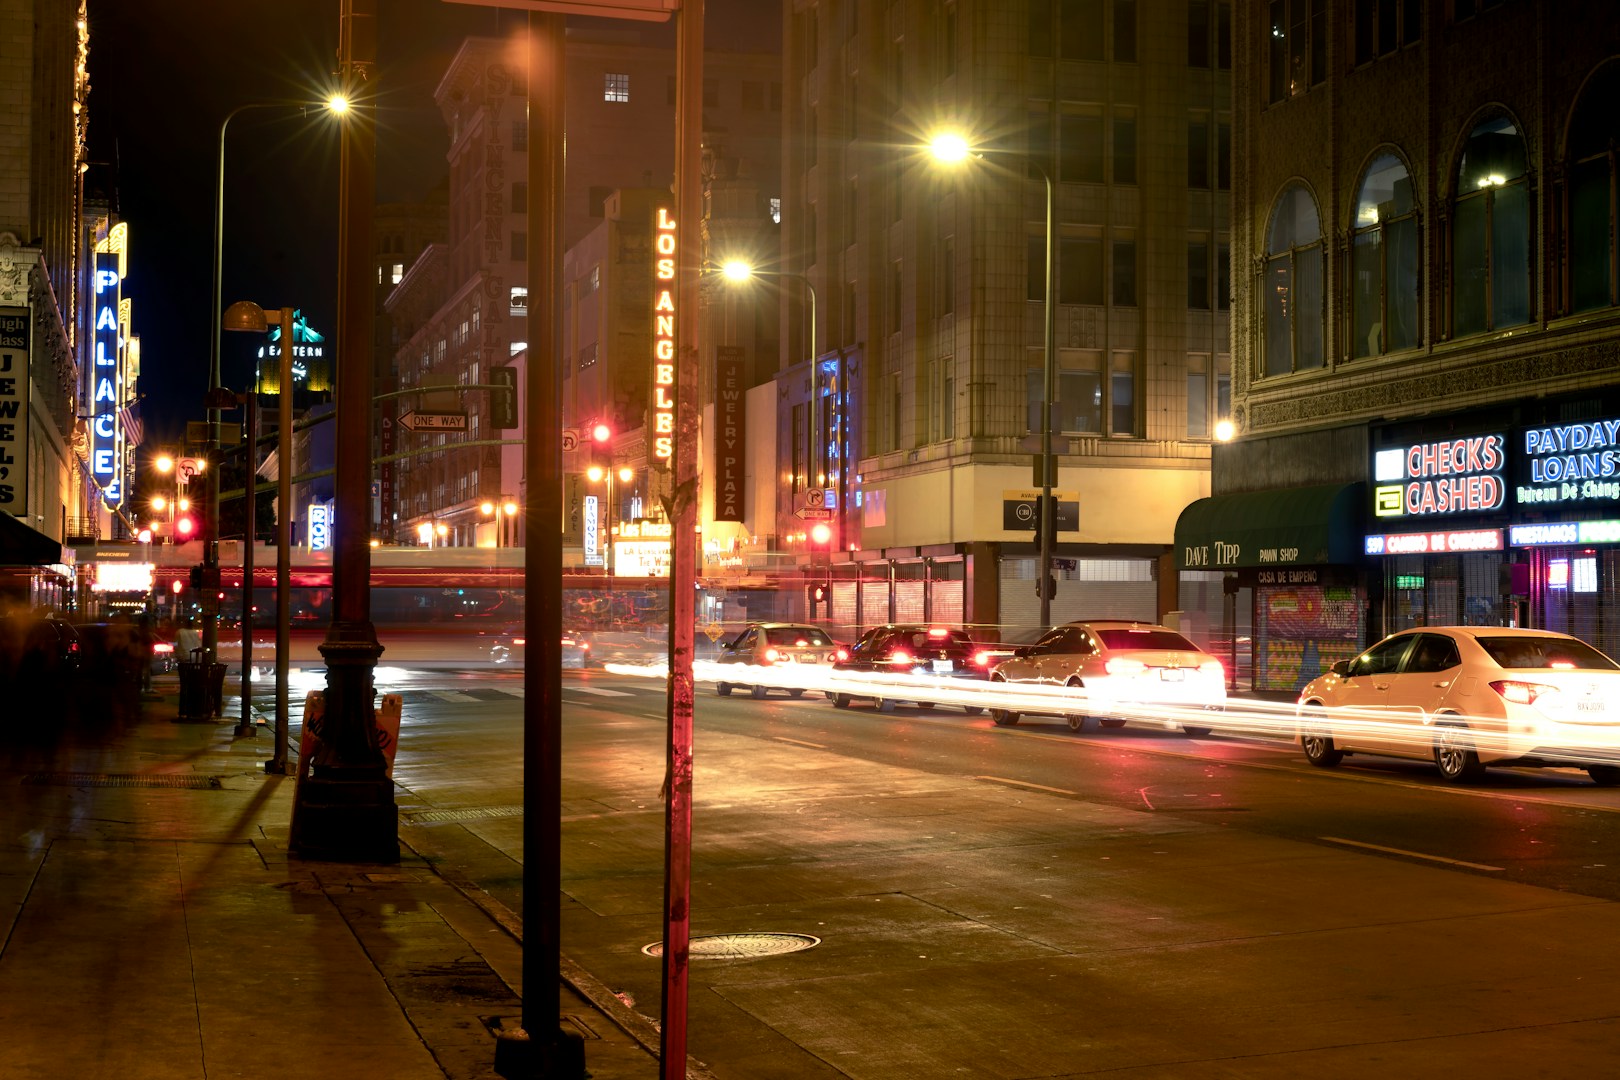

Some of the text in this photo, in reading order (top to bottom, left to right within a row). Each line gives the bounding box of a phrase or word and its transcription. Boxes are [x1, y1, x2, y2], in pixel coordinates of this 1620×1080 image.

[0, 317, 25, 333] igh
[0, 333, 25, 347] lass
[655, 208, 677, 458] LOS ANGELES
[268, 345, 323, 357] EATERN
[94, 270, 118, 474] PALACE
[0, 354, 20, 504] JEWEL'S
[413, 416, 462, 426] ONE WAY
[1525, 419, 1620, 455] PAYDAY
[722, 365, 740, 517] JEWELRY PLAZA
[1406, 435, 1498, 478] CHECKS
[382, 417, 393, 537] Burington
[1531, 450, 1616, 483] LOANS
[1405, 475, 1499, 515] CASHED
[1517, 480, 1620, 504] Bureau De Chang
[586, 497, 595, 554] DIAMONDS
[641, 521, 671, 537] Ange
[1185, 541, 1299, 567] DAVE TIPP PAWN SHOP
[1258, 569, 1318, 583] CASA DE EMPEÑO
